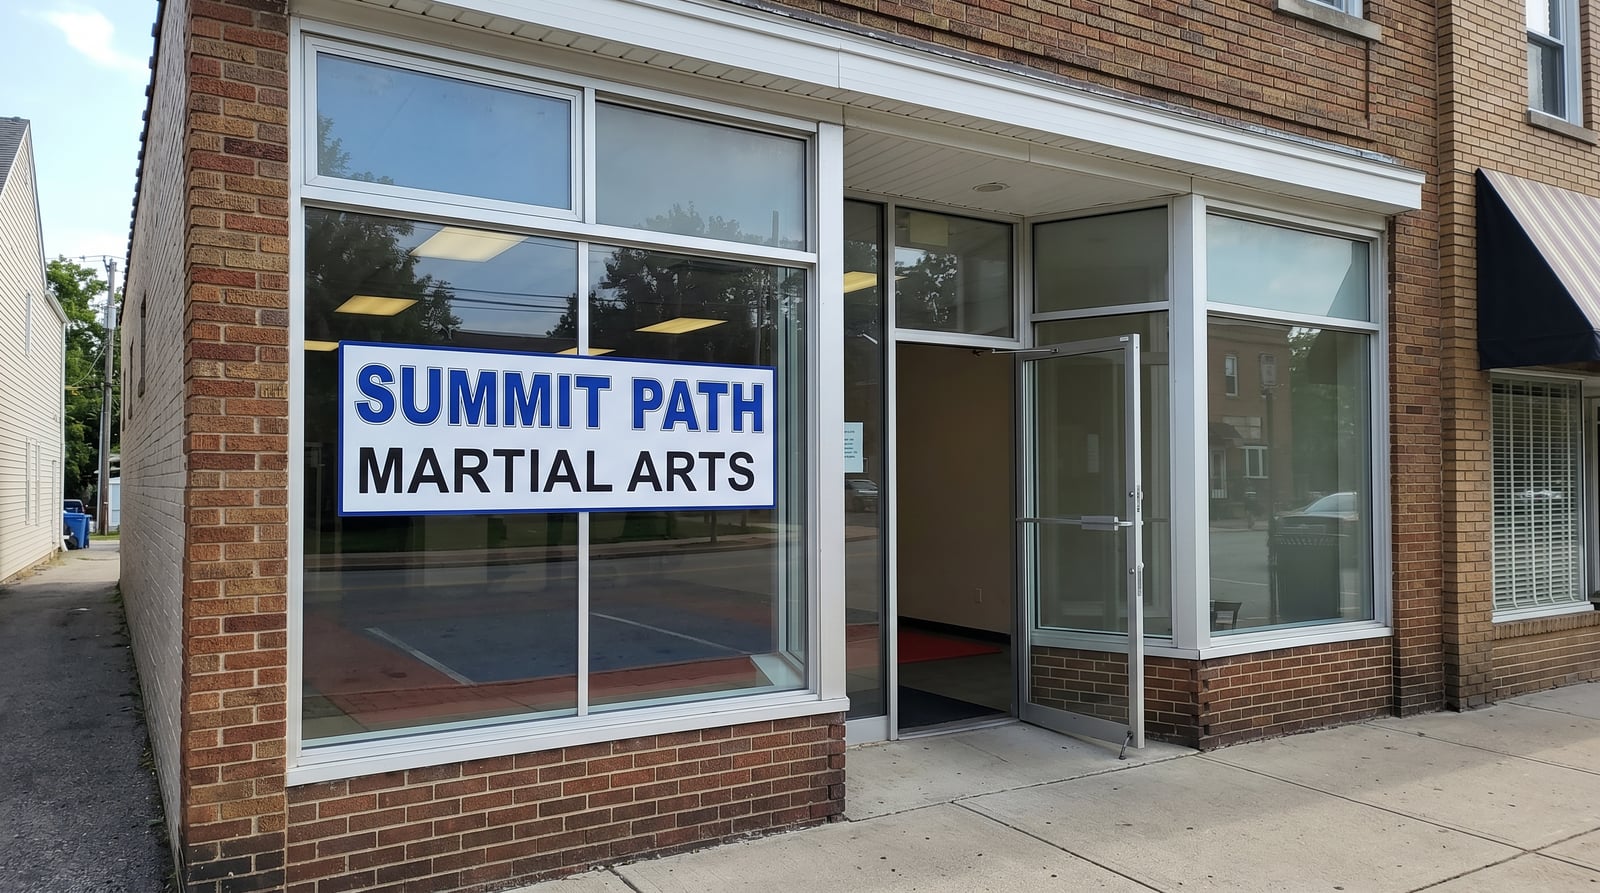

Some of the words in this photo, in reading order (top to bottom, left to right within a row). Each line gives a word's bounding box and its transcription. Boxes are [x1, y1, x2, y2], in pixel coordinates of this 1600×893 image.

[354, 362, 612, 429] SUMMIT
[631, 376, 765, 434] PATH
[358, 446, 613, 494] MARTIAL
[627, 449, 755, 492] ARTS
